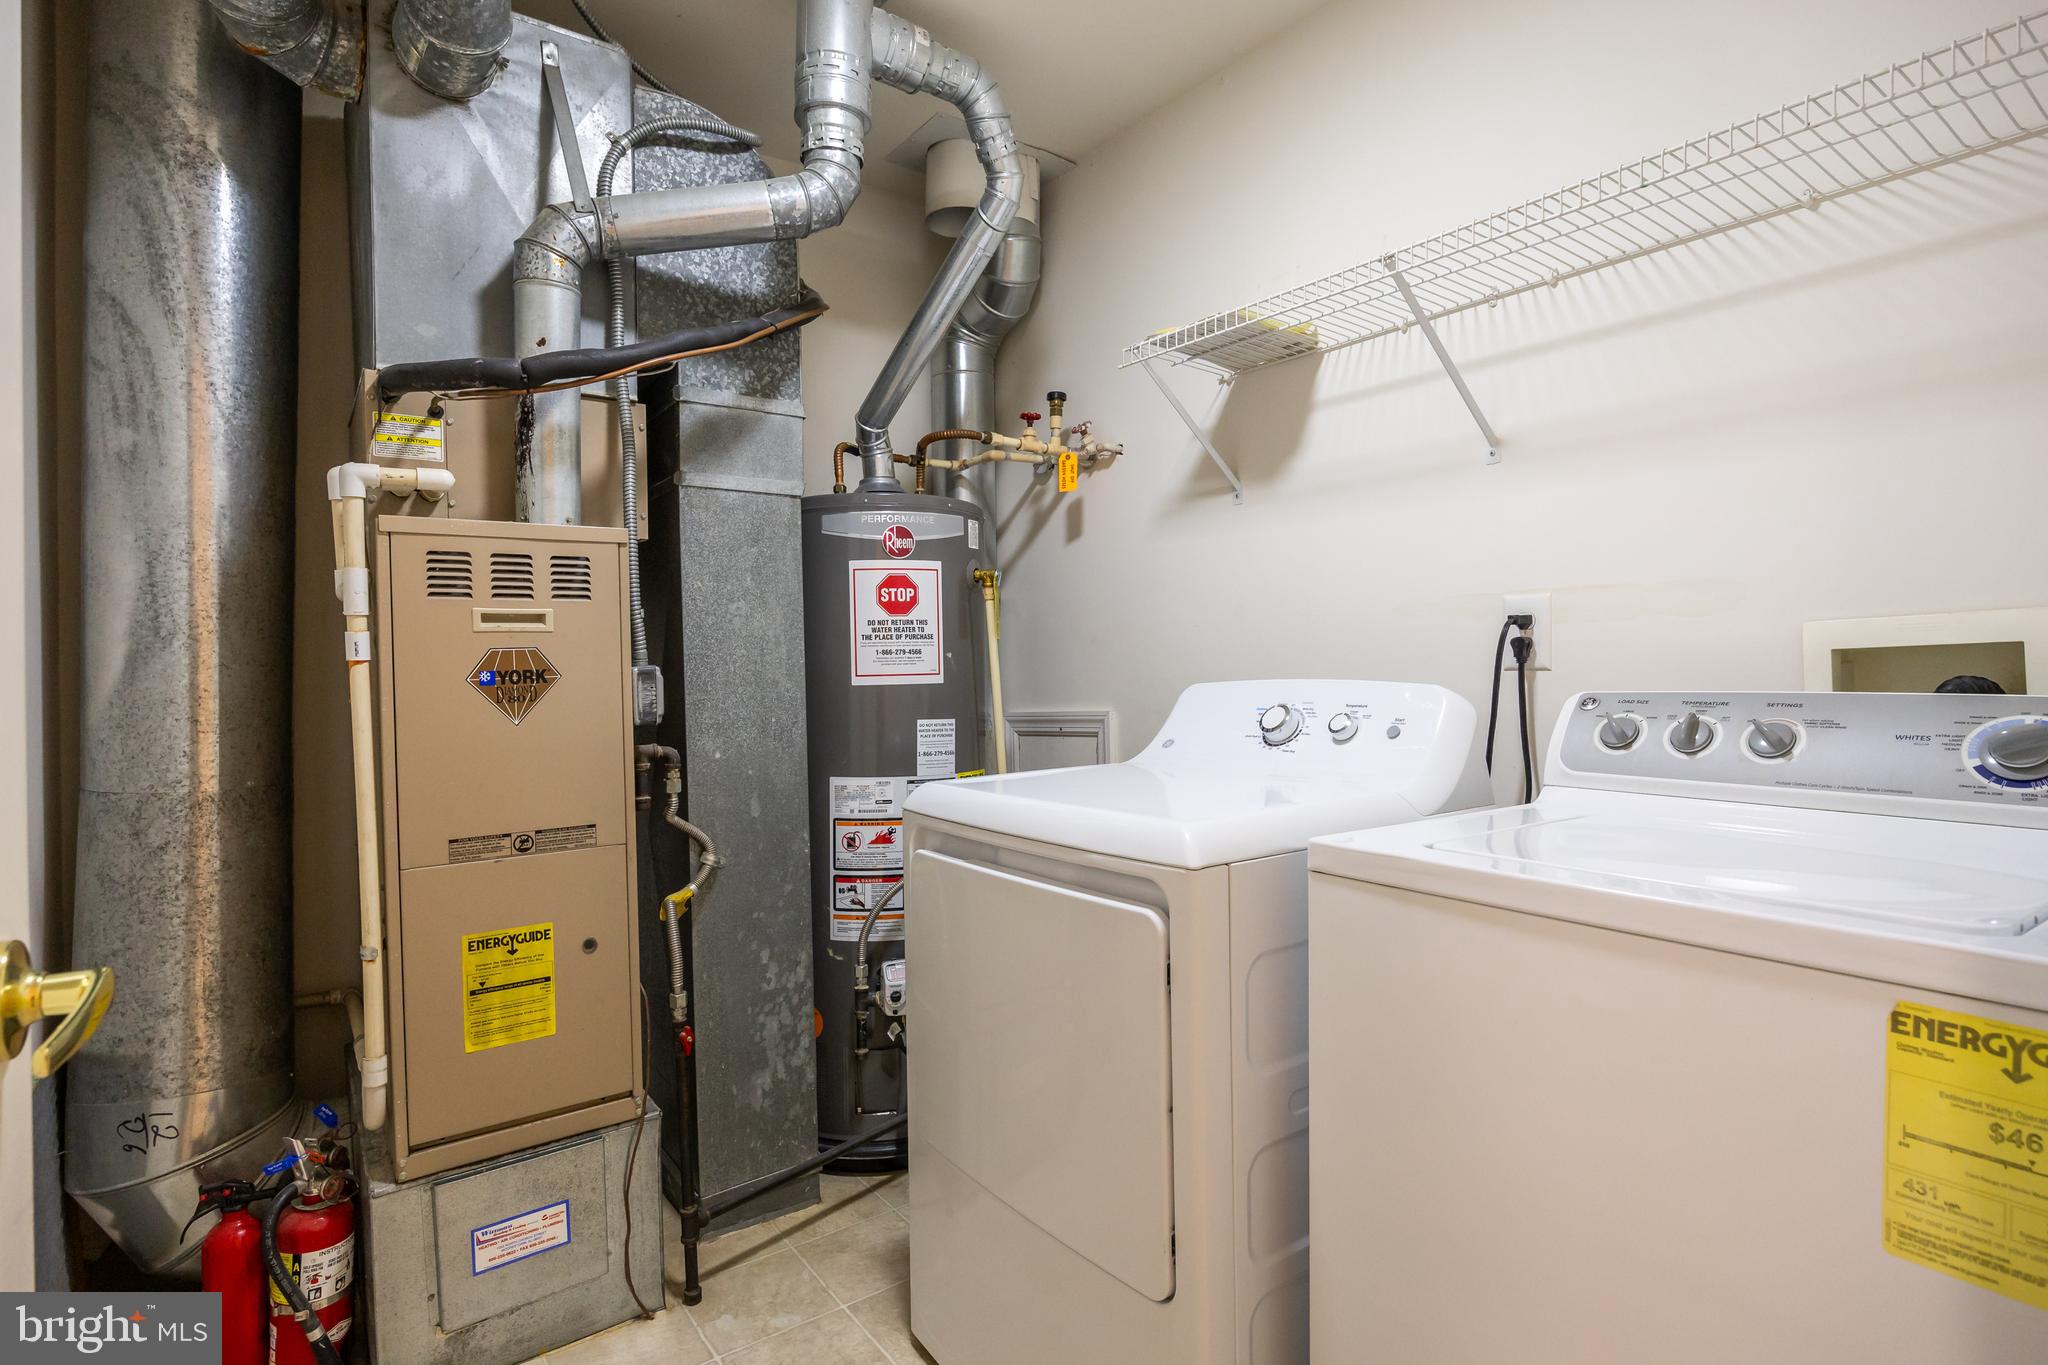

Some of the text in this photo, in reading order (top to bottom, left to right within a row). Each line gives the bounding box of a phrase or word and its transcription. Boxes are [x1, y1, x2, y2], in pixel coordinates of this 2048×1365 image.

[399, 416, 426, 424] CAUTION
[396, 436, 429, 445] ATTENTION
[860, 514, 935, 524] PERFORMANCE
[886, 525, 914, 553] Rheem
[880, 587, 915, 602] STOP
[496, 668, 548, 685] YORK
[496, 685, 537, 703] DIAMOND
[468, 929, 551, 955] ENERGYGUIDE
[1939, 1090, 1983, 1108] Estimated
[1984, 1103, 2013, 1117] Yearly
[1988, 1121, 2044, 1153] $46
[1902, 1178, 1939, 1200] 431
[1904, 1211, 1923, 1223] Your
[478, 1241, 498, 1250] HEATING
[509, 1227, 539, 1241] CONDITIONING
[542, 1219, 564, 1229] PLUMBING
[293, 1263, 300, 1272] A
